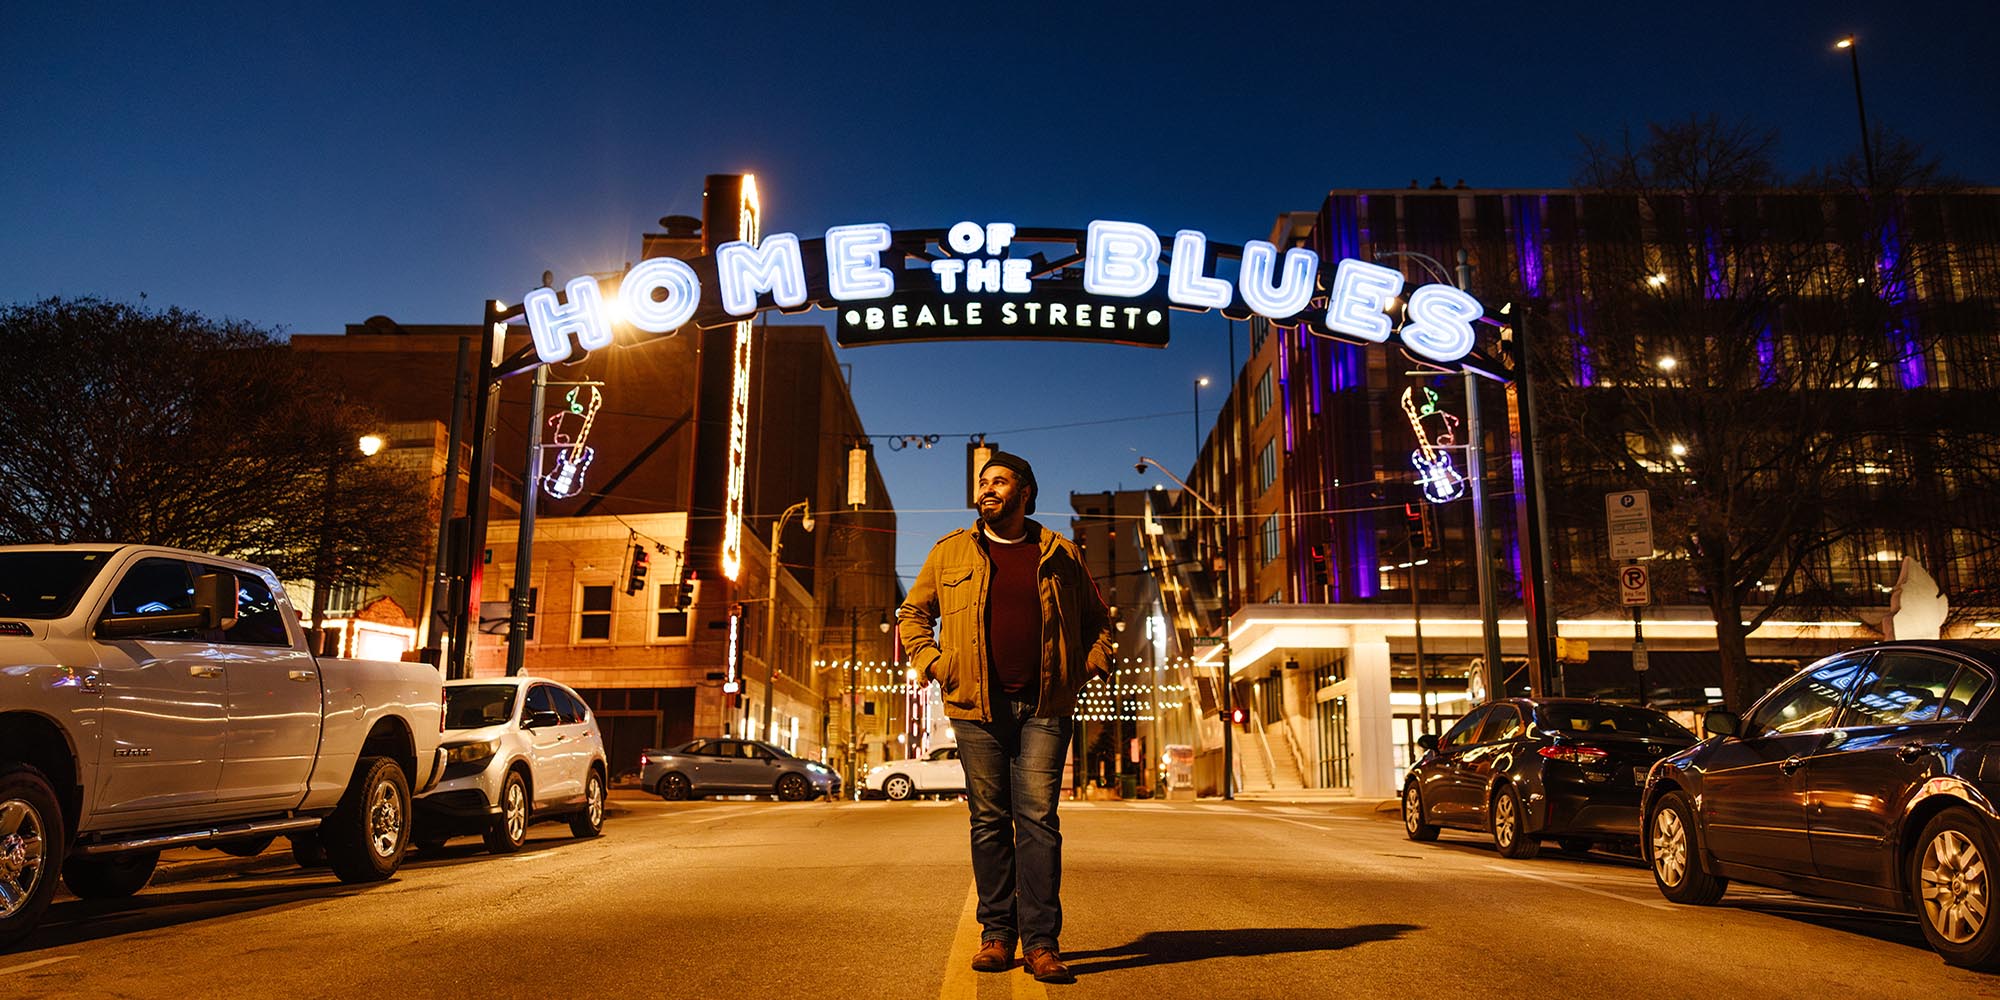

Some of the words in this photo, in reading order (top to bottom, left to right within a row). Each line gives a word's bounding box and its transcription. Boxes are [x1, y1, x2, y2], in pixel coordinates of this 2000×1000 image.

[948, 221, 1016, 254] OF
[524, 222, 894, 363] HOME
[931, 259, 1032, 293] THE
[1084, 220, 1483, 361] BLUES
[865, 303, 982, 330] BEALE
[1002, 303, 1141, 330] STREET
